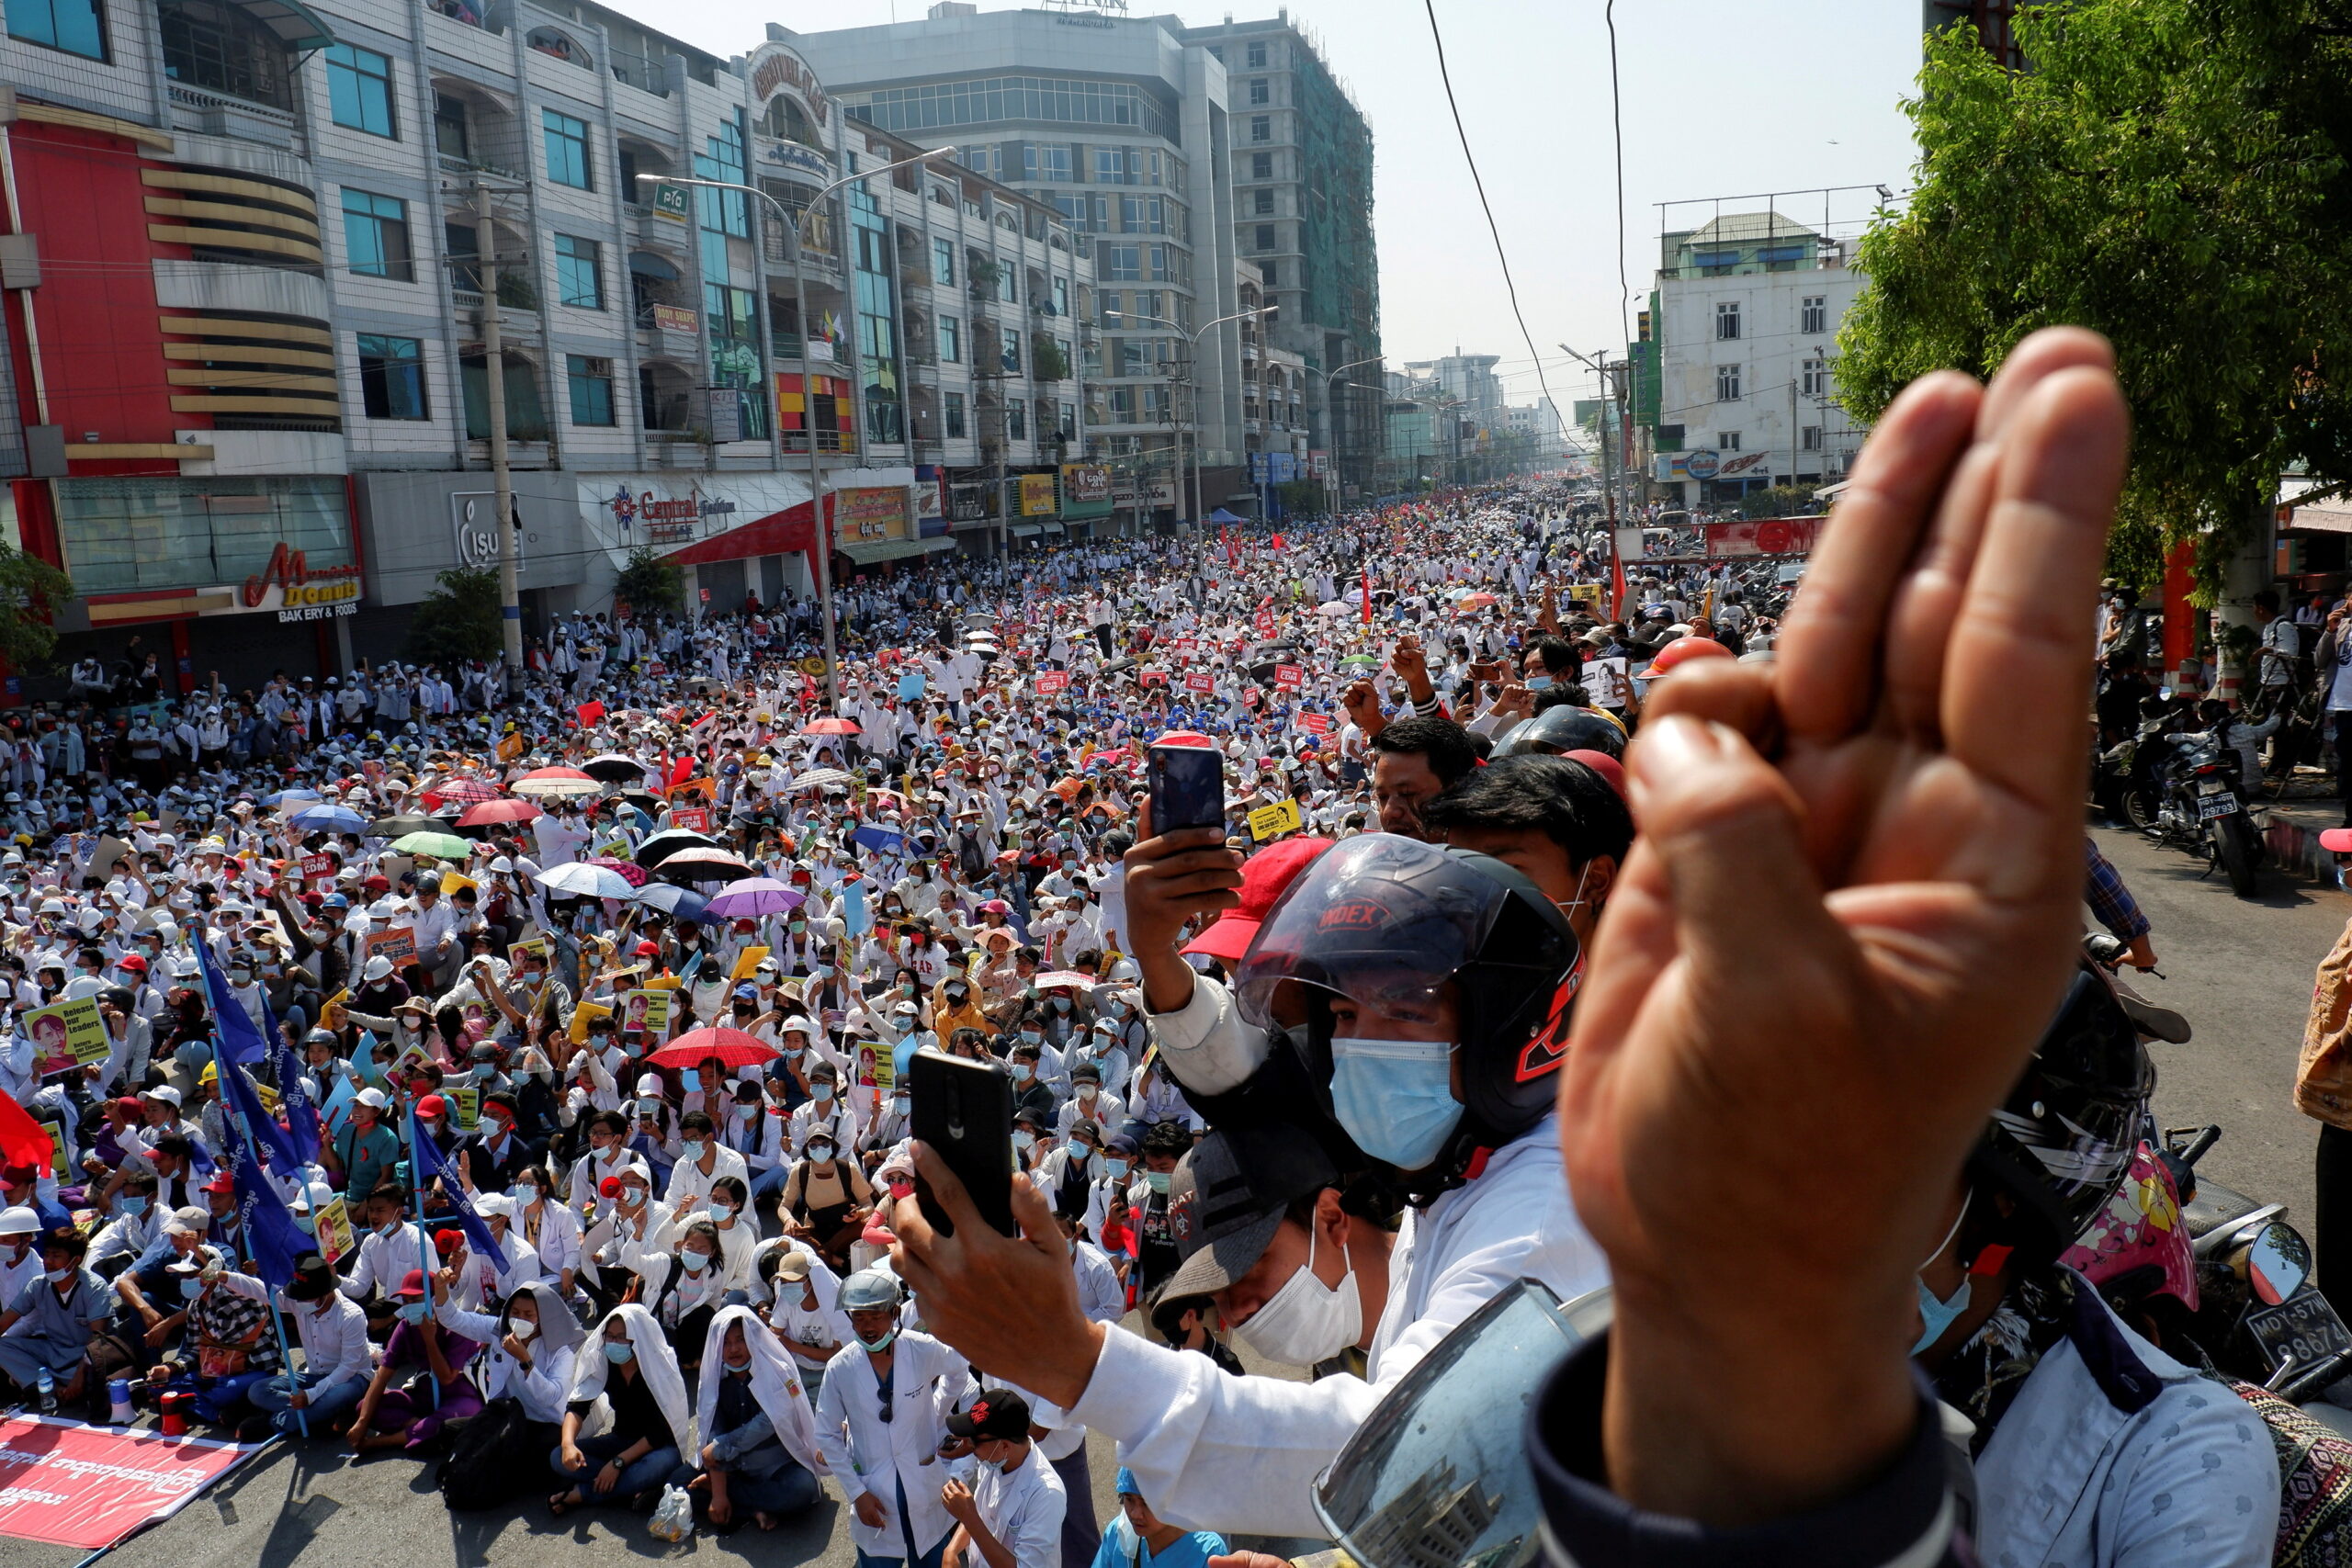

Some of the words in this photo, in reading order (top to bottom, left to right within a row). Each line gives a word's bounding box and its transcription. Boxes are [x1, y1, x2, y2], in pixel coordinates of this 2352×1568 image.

[802, 69, 828, 128] PLAZA
[658, 308, 673, 320] BODY
[675, 310, 695, 323] SHAPE
[712, 391, 735, 401] KIT
[640, 488, 698, 521] Central
[334, 603, 357, 617] FOODS
[1280, 673, 1297, 682] CDM
[1191, 681, 1208, 689] CDM
[2203, 802, 2234, 817] 29793
[304, 863, 328, 874] CDM
[1318, 904, 1378, 928] INDEX
[62, 1003, 96, 1018] Release
[65, 1016, 80, 1026] our
[68, 1020, 100, 1034] Leaders
[73, 1039, 92, 1048] Return
[85, 1041, 105, 1051] Elected
[76, 1044, 109, 1058] Government
[2254, 1296, 2331, 1337] MDY-57W
[2277, 1321, 2348, 1368] 88674
